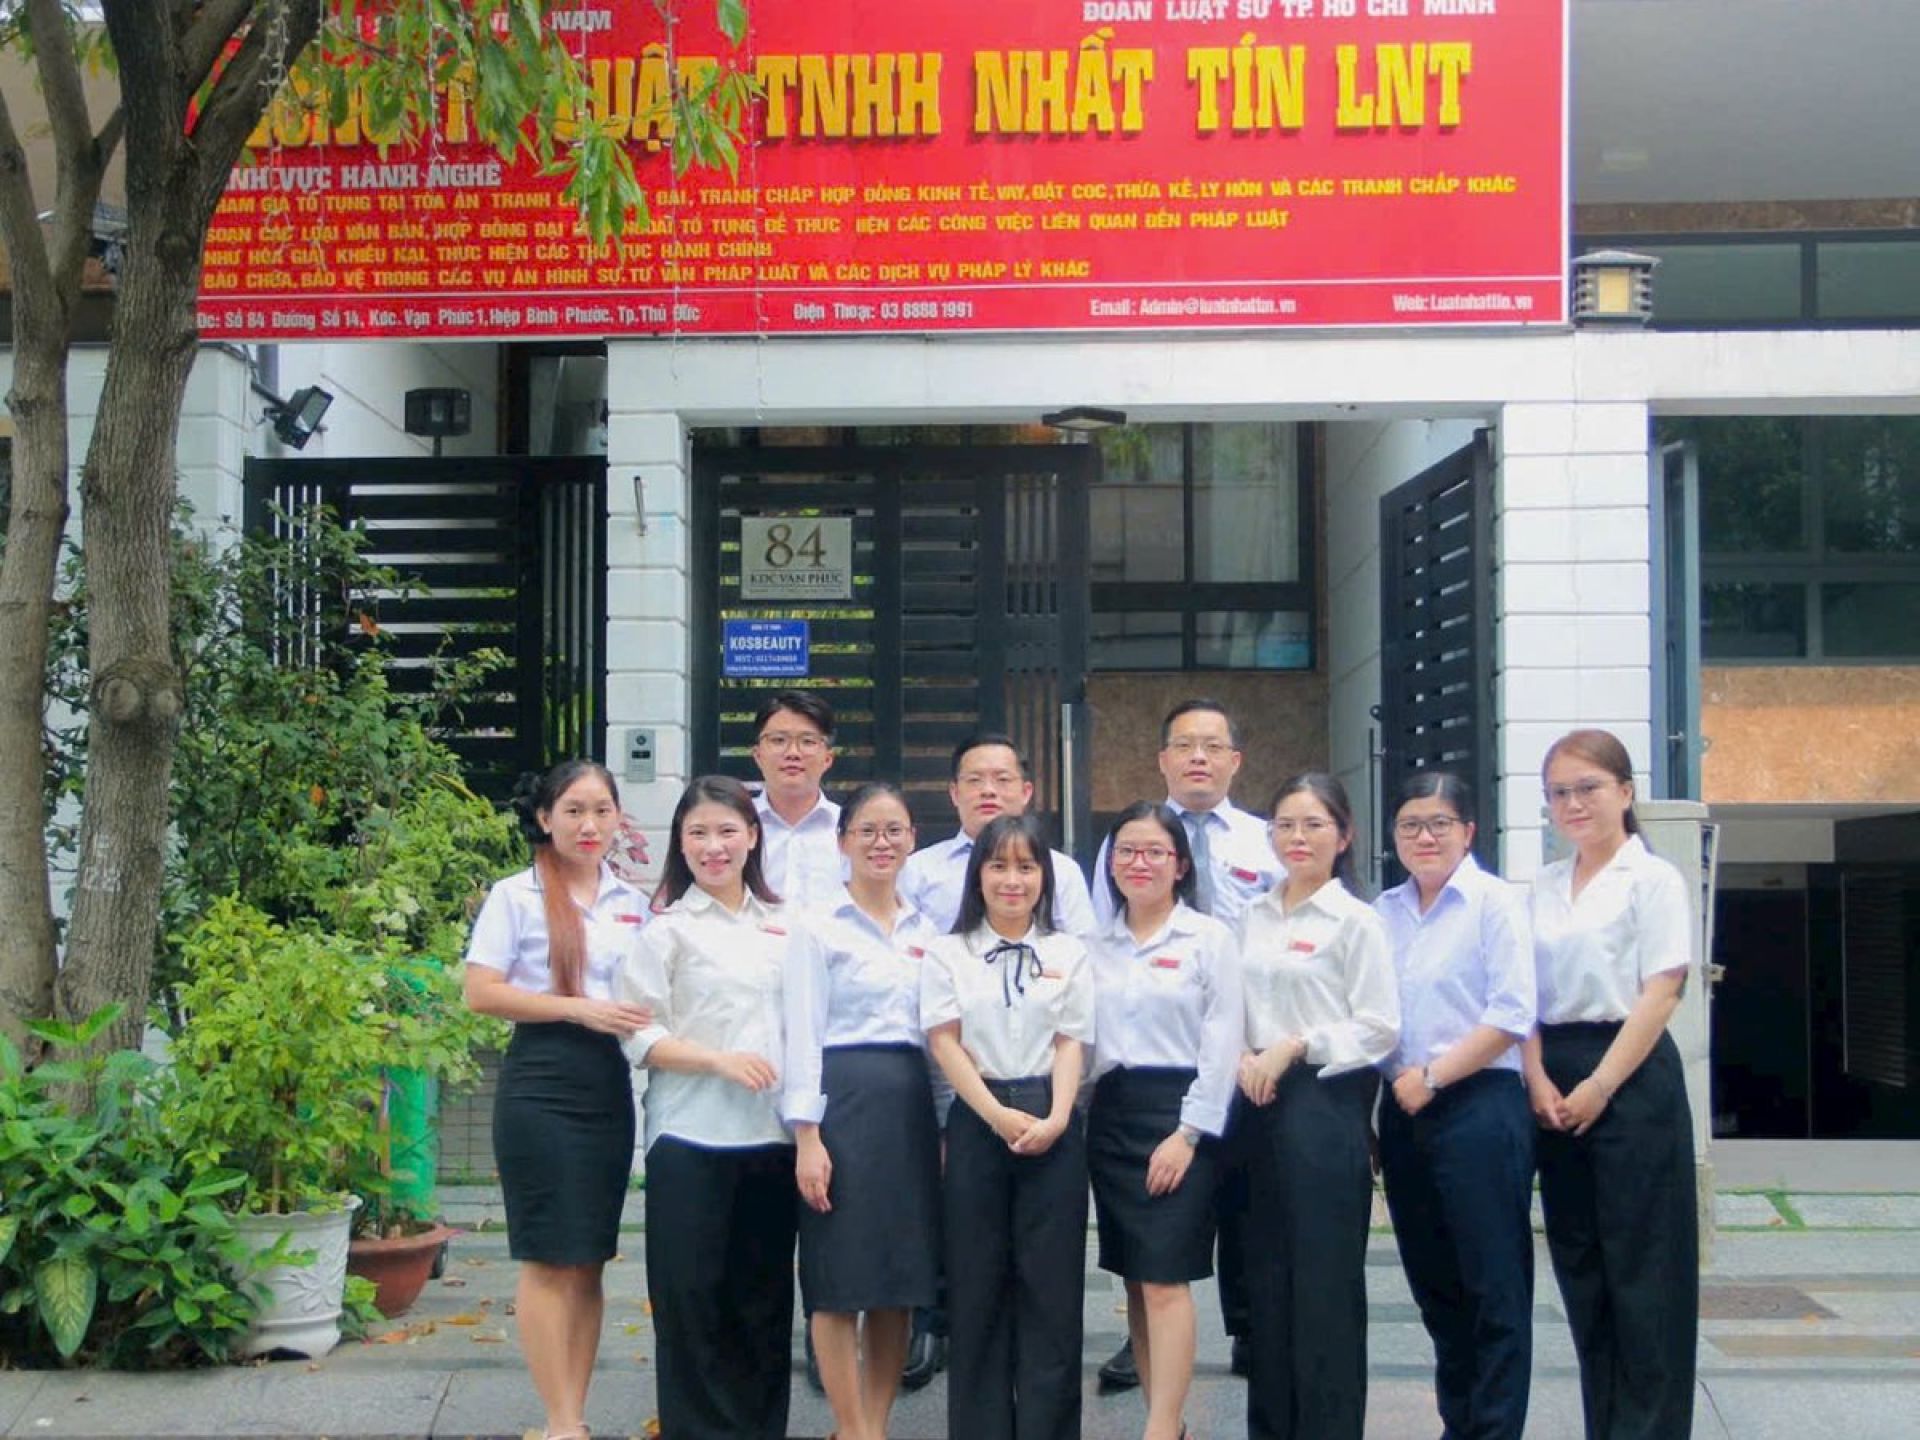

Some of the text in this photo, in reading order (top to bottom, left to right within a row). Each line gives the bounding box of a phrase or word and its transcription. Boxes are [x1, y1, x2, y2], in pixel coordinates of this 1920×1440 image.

[551, 10, 612, 31] NAM
[755, 53, 941, 137] TNHH
[974, 27, 1154, 133] NHẤT
[1188, 32, 1305, 131] TÍN
[1336, 42, 1472, 127] LNT
[492, 192, 550, 208] TRANH
[701, 188, 757, 205] TRANH
[918, 184, 960, 202] KINH
[1298, 178, 1334, 196] CÁC
[1342, 178, 1402, 194] TRANH
[1468, 175, 1517, 193] KHÁC
[897, 215, 931, 232] CÁC
[939, 213, 987, 231] CÔNG
[1088, 212, 1137, 230] QUAN
[373, 271, 430, 287] TRONG
[836, 262, 871, 281] CÁC
[958, 260, 1007, 279] PHÁP
[1040, 259, 1089, 278] KHÁC
[880, 302, 899, 319] 03
[941, 300, 973, 318] 1991
[764, 523, 827, 568] 84
[729, 636, 802, 650] KOSBEAUTY
